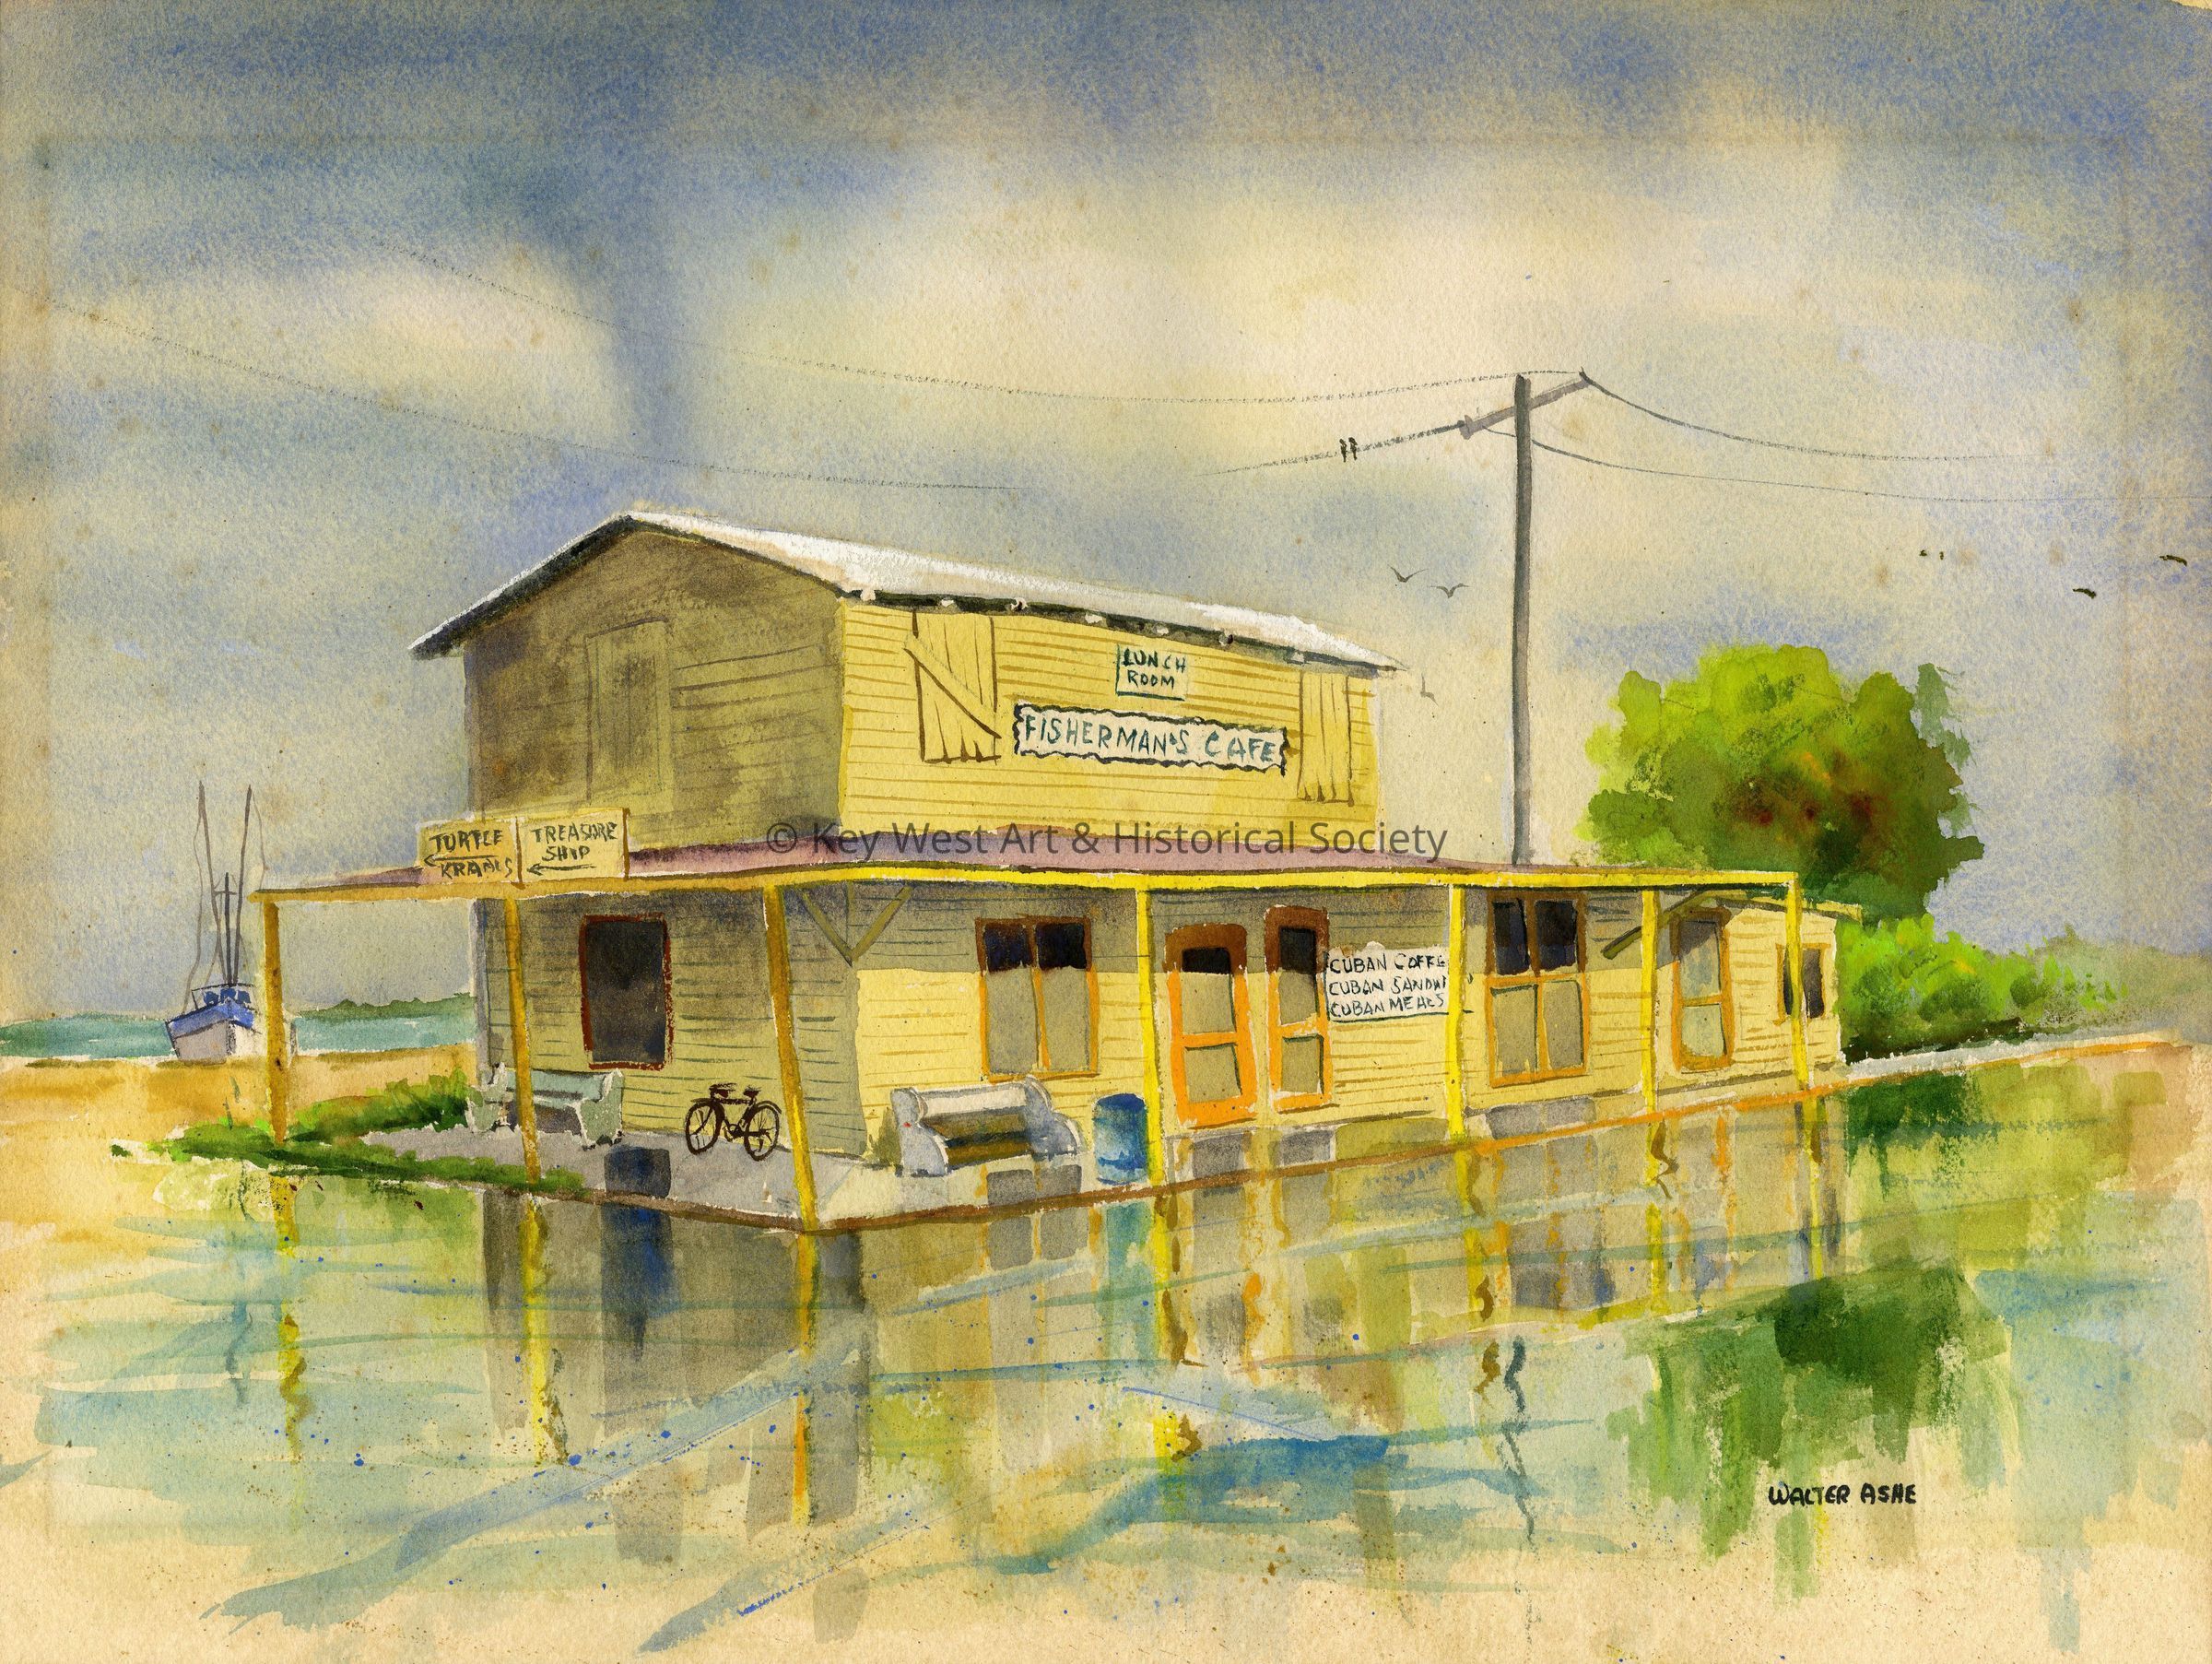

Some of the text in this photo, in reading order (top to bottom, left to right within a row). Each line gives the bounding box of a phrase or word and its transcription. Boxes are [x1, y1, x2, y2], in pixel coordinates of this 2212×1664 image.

[1123, 648, 1186, 674] LUNCH
[1127, 670, 1176, 689] ROOM
[1025, 714, 1277, 763] FISHERMAN'S CAFE
[429, 829, 503, 853] TURTLE
[531, 821, 618, 844] TREASURE
[1329, 952, 1387, 974] CUBAN
[1328, 978, 1384, 997] CUBAN
[1329, 992, 1445, 1018] CUBAN MEALS
[1768, 1481, 1917, 1506] WALTER ASHE
